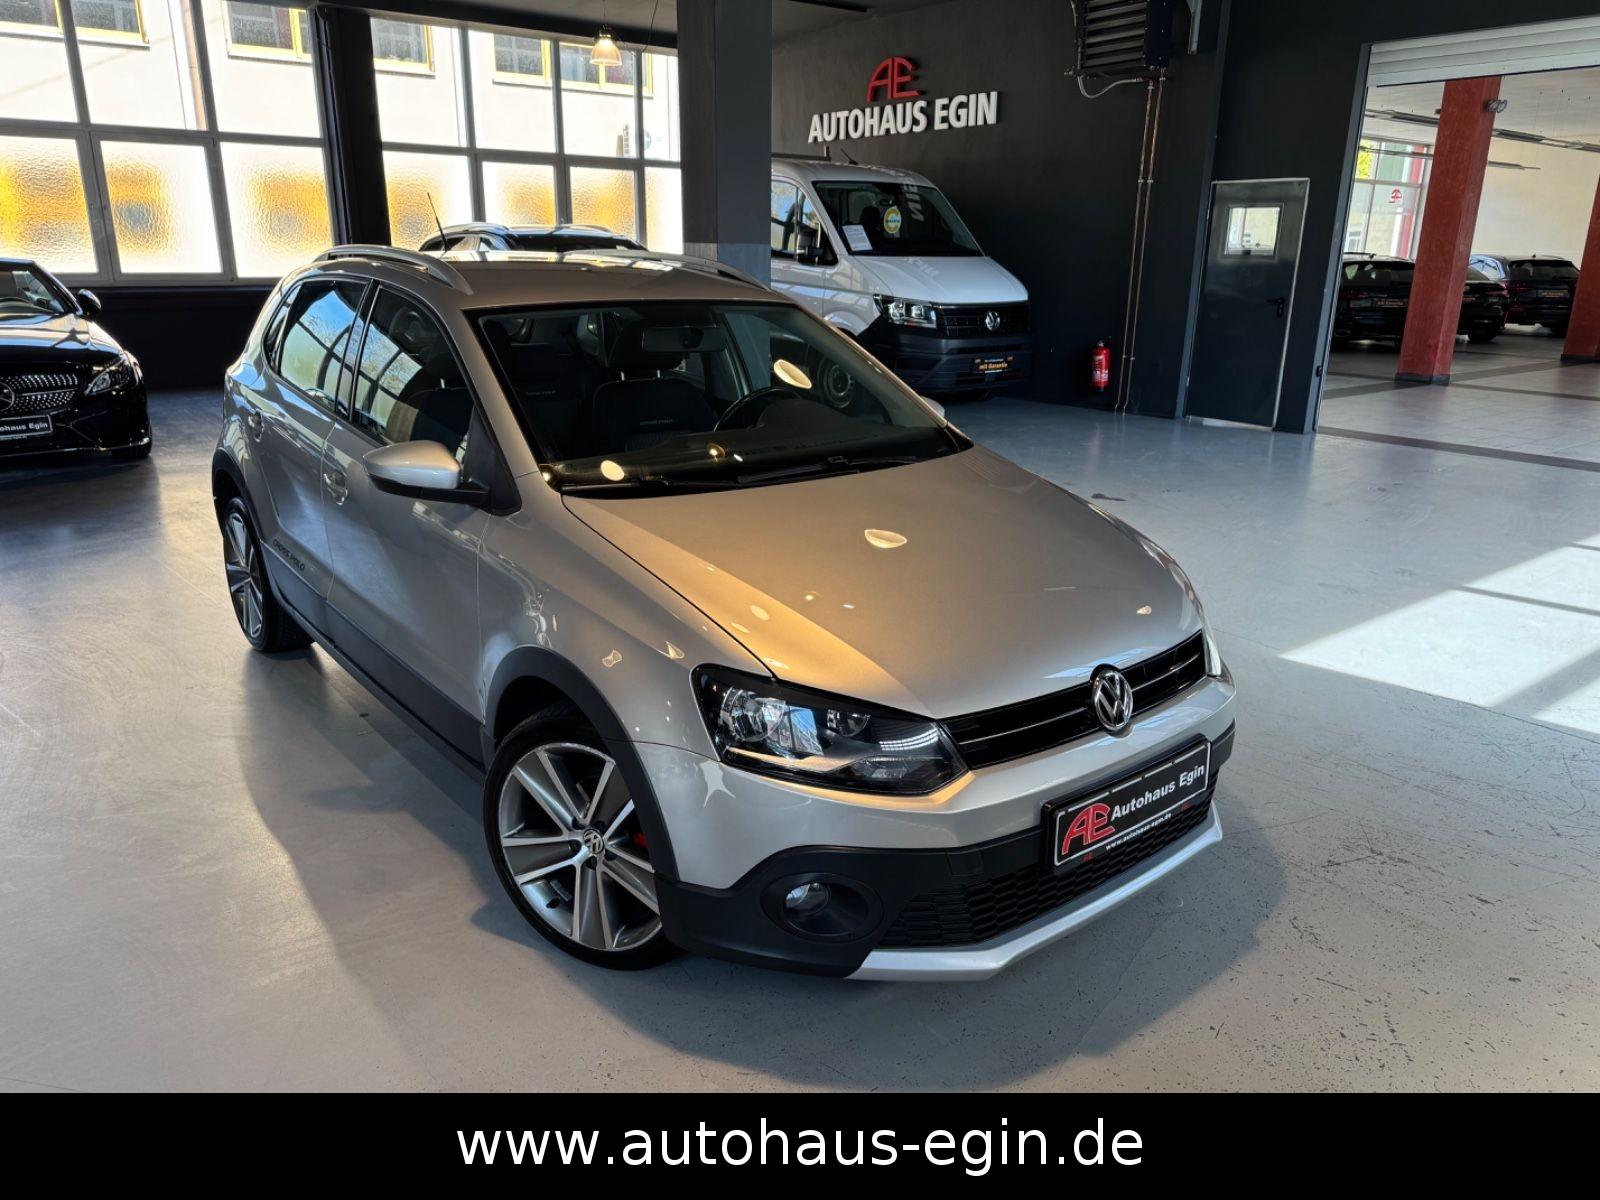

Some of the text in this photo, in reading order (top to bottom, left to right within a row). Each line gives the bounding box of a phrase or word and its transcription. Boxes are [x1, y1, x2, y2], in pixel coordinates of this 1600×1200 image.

[808, 91, 998, 144] AUTOHAUS EGIN
[1111, 764, 1205, 821] Autohaus Egin
